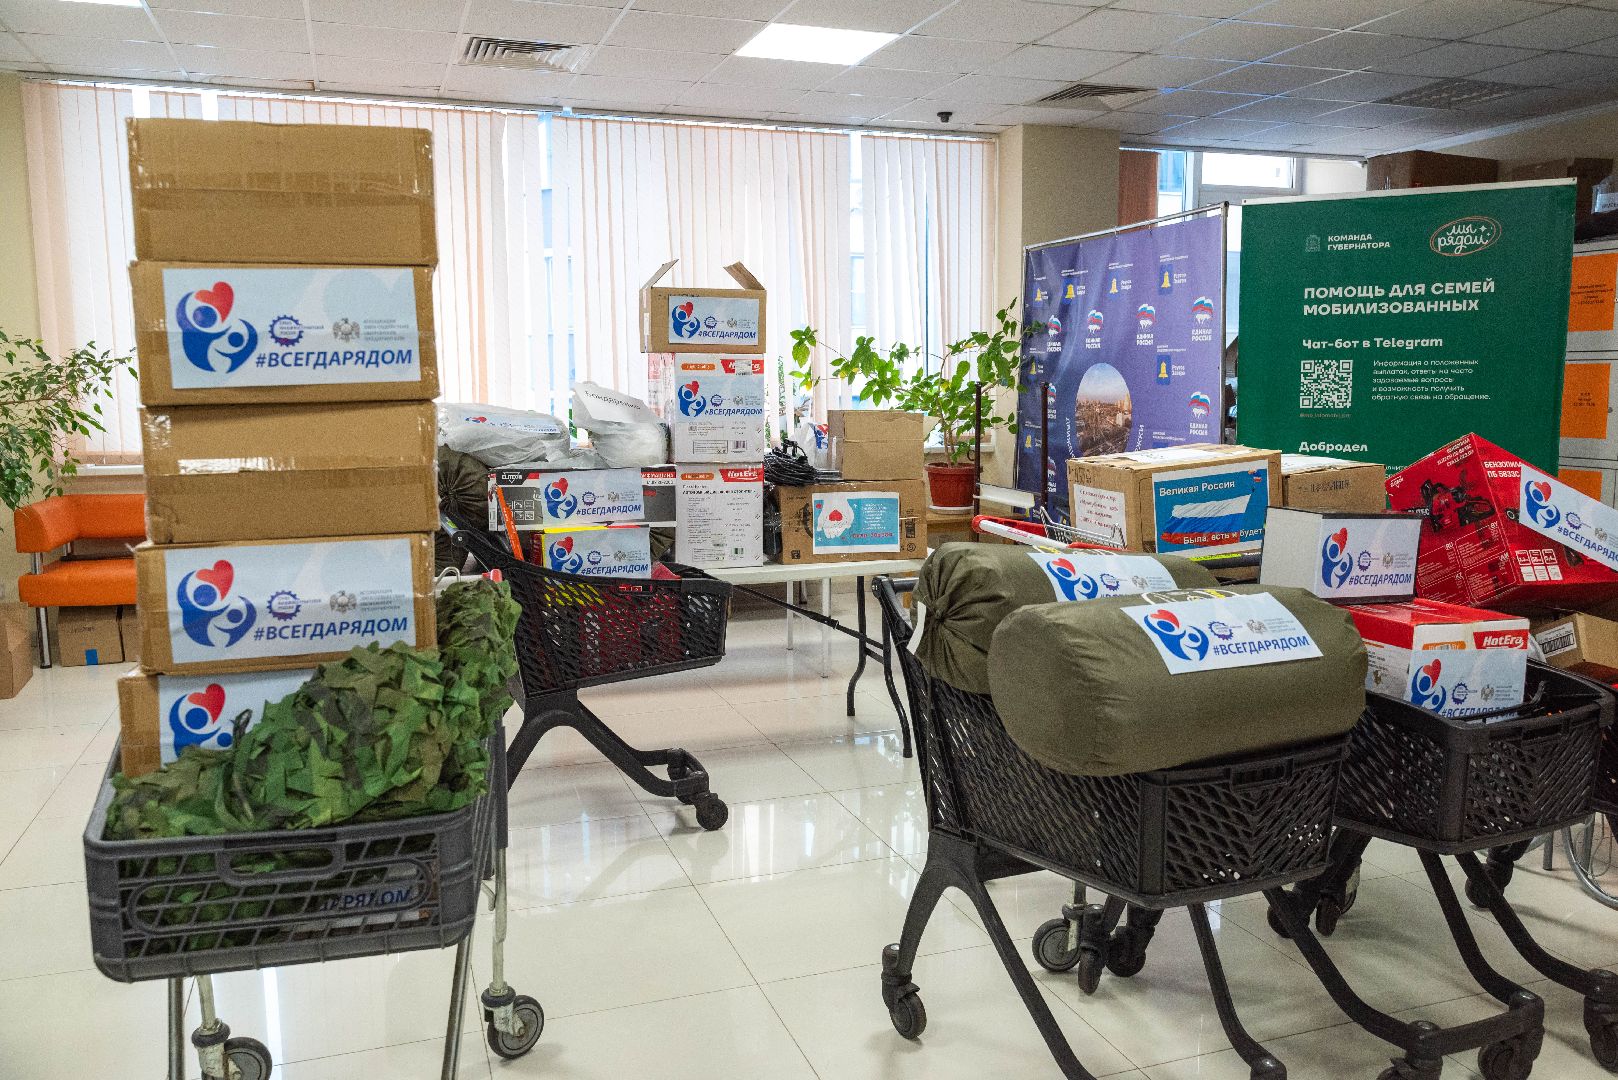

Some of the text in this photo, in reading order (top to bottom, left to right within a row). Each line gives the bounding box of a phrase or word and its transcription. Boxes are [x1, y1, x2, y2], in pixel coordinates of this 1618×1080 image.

[1446, 223, 1477, 236] мы
[1328, 233, 1372, 242] КОМАНДА
[1437, 234, 1489, 254] рядом
[1327, 241, 1391, 251] ГУБЕРНАТОРА
[1303, 277, 1496, 299] ПОМОЩЬ ДЛЯ СЕМЕЙ
[1302, 299, 1480, 316] МОБИЛИЗОВАННЫХ
[697, 330, 757, 340] #ВСЕГДАРЯДОМ
[1302, 337, 1444, 350] Чат-бот в Telegram
[255, 347, 412, 370] #ВСЕГДАРЯДОМ
[1430, 385, 1465, 393] получить
[1444, 393, 1491, 401] обращение.
[704, 408, 763, 417] #ВСЕГДАРЯДОМ
[1298, 441, 1369, 453] Добродел
[1159, 480, 1236, 497] Великая Россия
[576, 504, 642, 516] #ВСЕГДАРЯДОМ
[1211, 533, 1230, 542] есть
[1239, 527, 1263, 538] будет
[580, 563, 649, 576] #ВСЕГДАРЯДОМ
[1348, 573, 1412, 587] #ВСЕГДАРЯДОМ
[253, 616, 408, 641] #ВСЕГДАРЯДОМ
[1212, 635, 1310, 657] #ВСЕГДАРЯДОМ
[1482, 635, 1524, 649] HotEra
